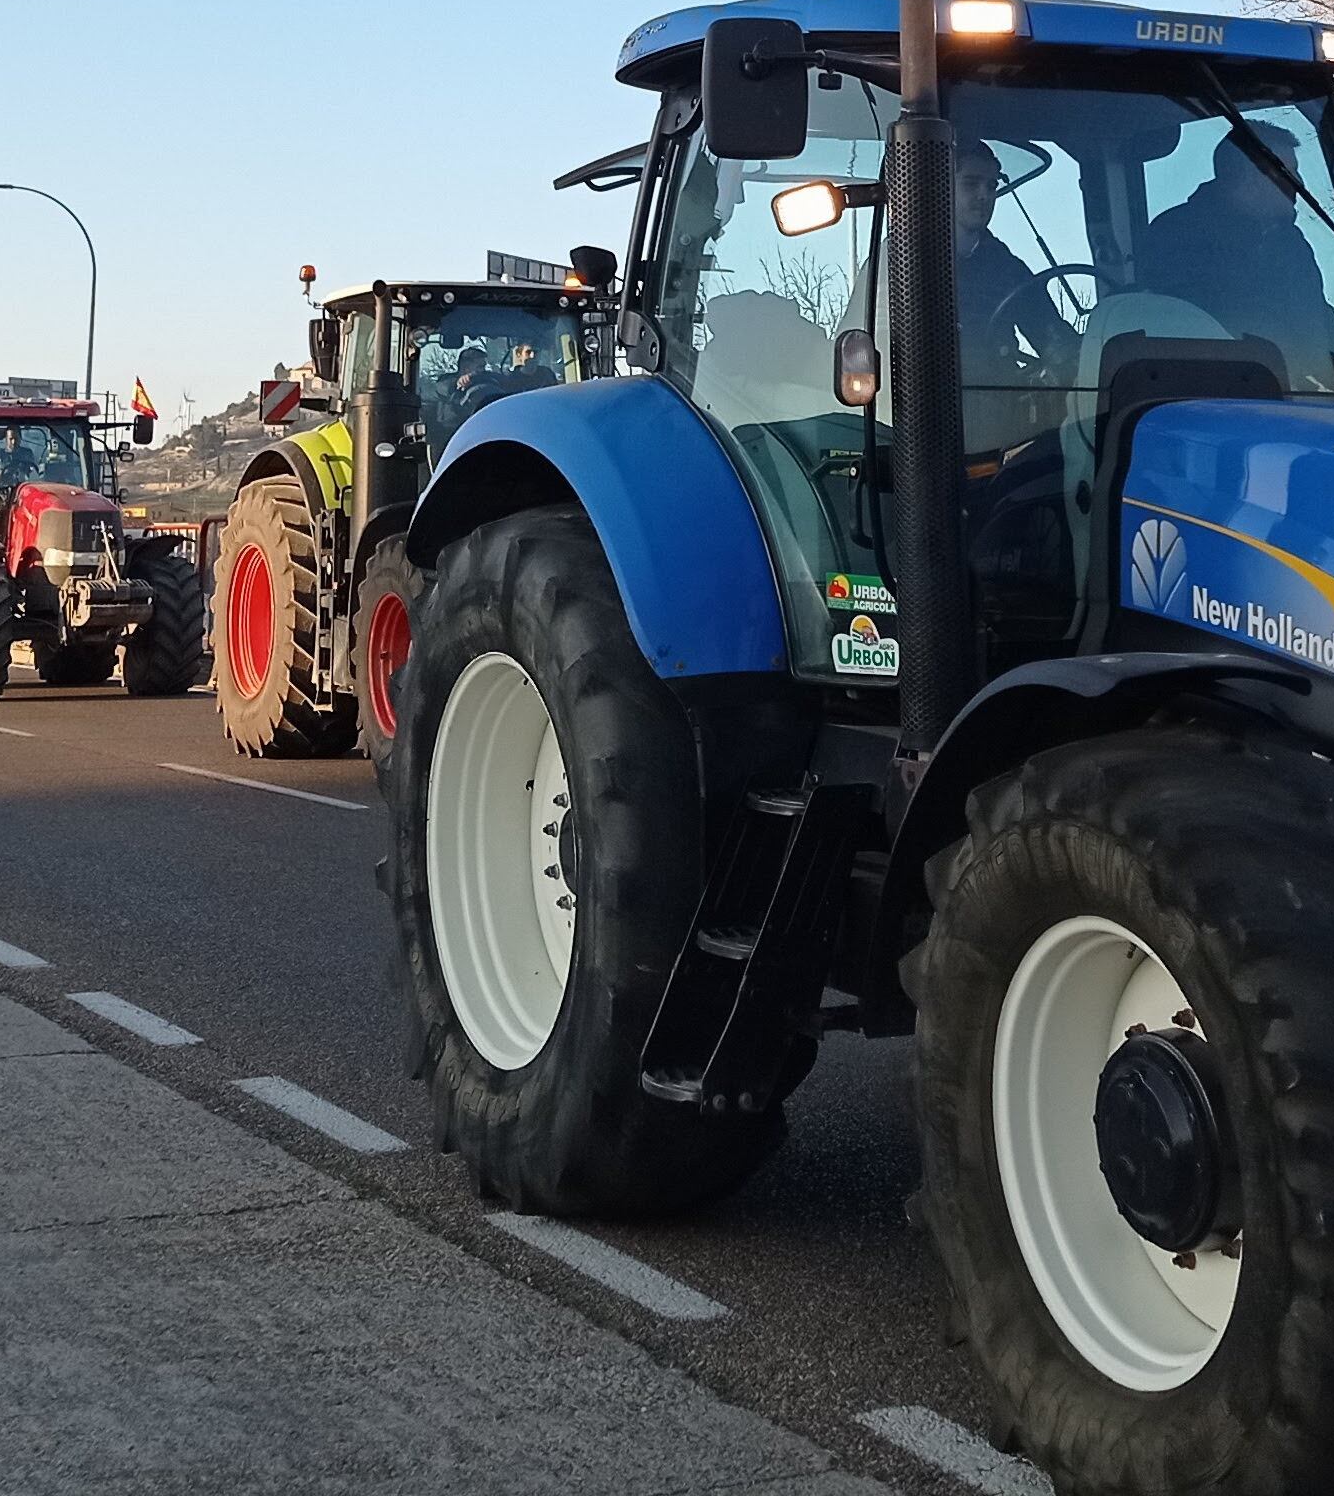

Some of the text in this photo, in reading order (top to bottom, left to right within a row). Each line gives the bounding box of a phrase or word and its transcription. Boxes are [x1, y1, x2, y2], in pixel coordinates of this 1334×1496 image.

[1136, 20, 1223, 45] URBON
[473, 291, 540, 302] AXION
[853, 601, 897, 615] AGRICOLA
[1192, 585, 1241, 632] New
[837, 639, 895, 668] URBON
